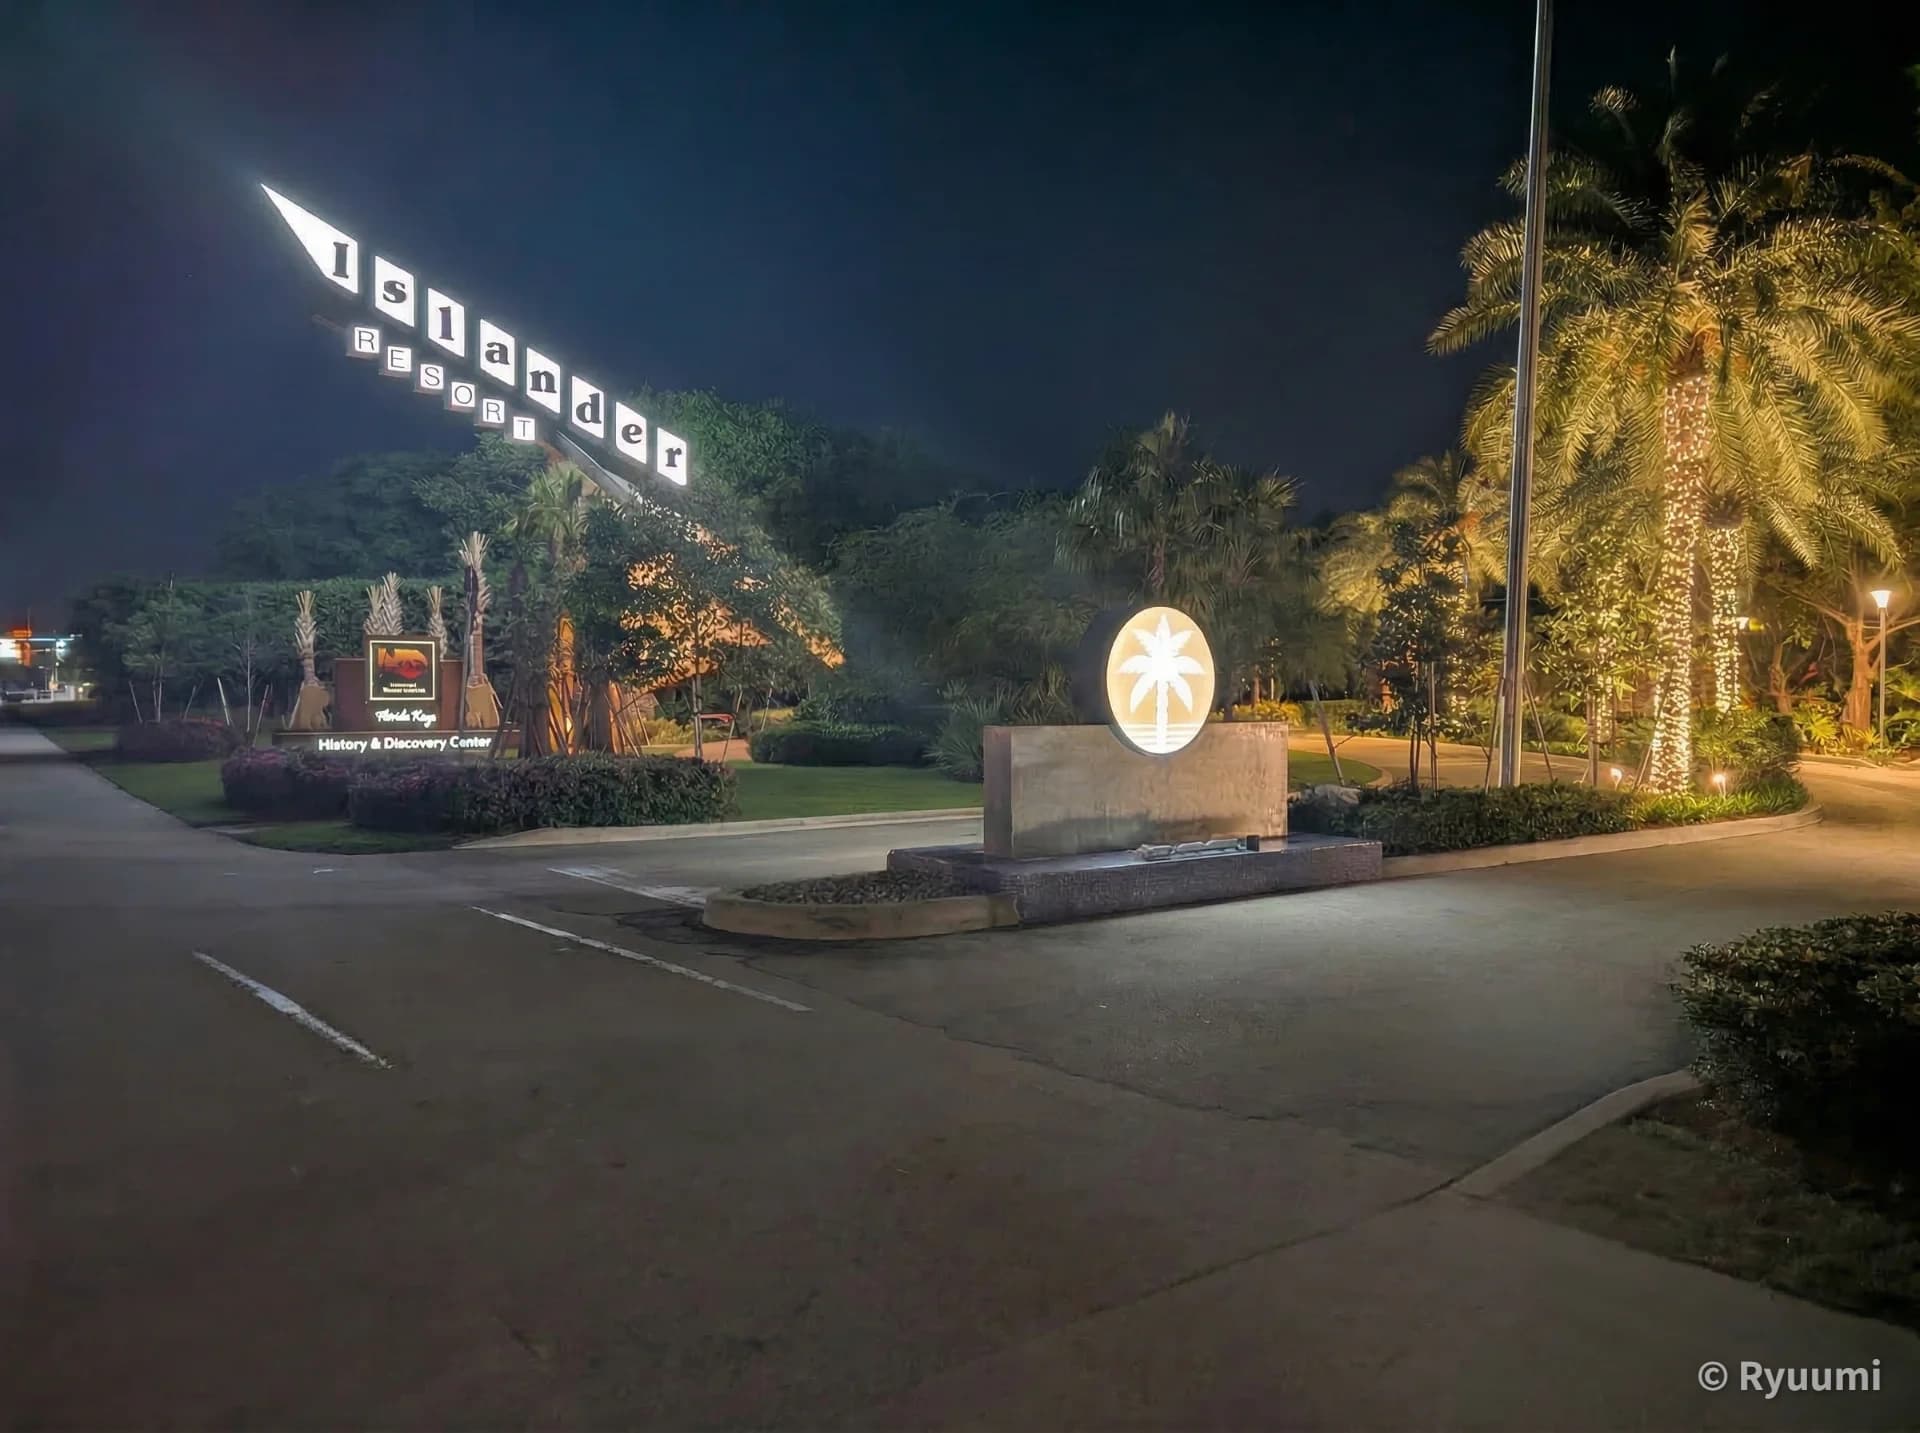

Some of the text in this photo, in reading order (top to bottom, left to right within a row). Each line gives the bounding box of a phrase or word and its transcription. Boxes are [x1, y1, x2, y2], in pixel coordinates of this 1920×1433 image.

[332, 241, 683, 469] Islander
[357, 329, 532, 438] RESORT
[318, 735, 492, 753] History & Discovery Center
